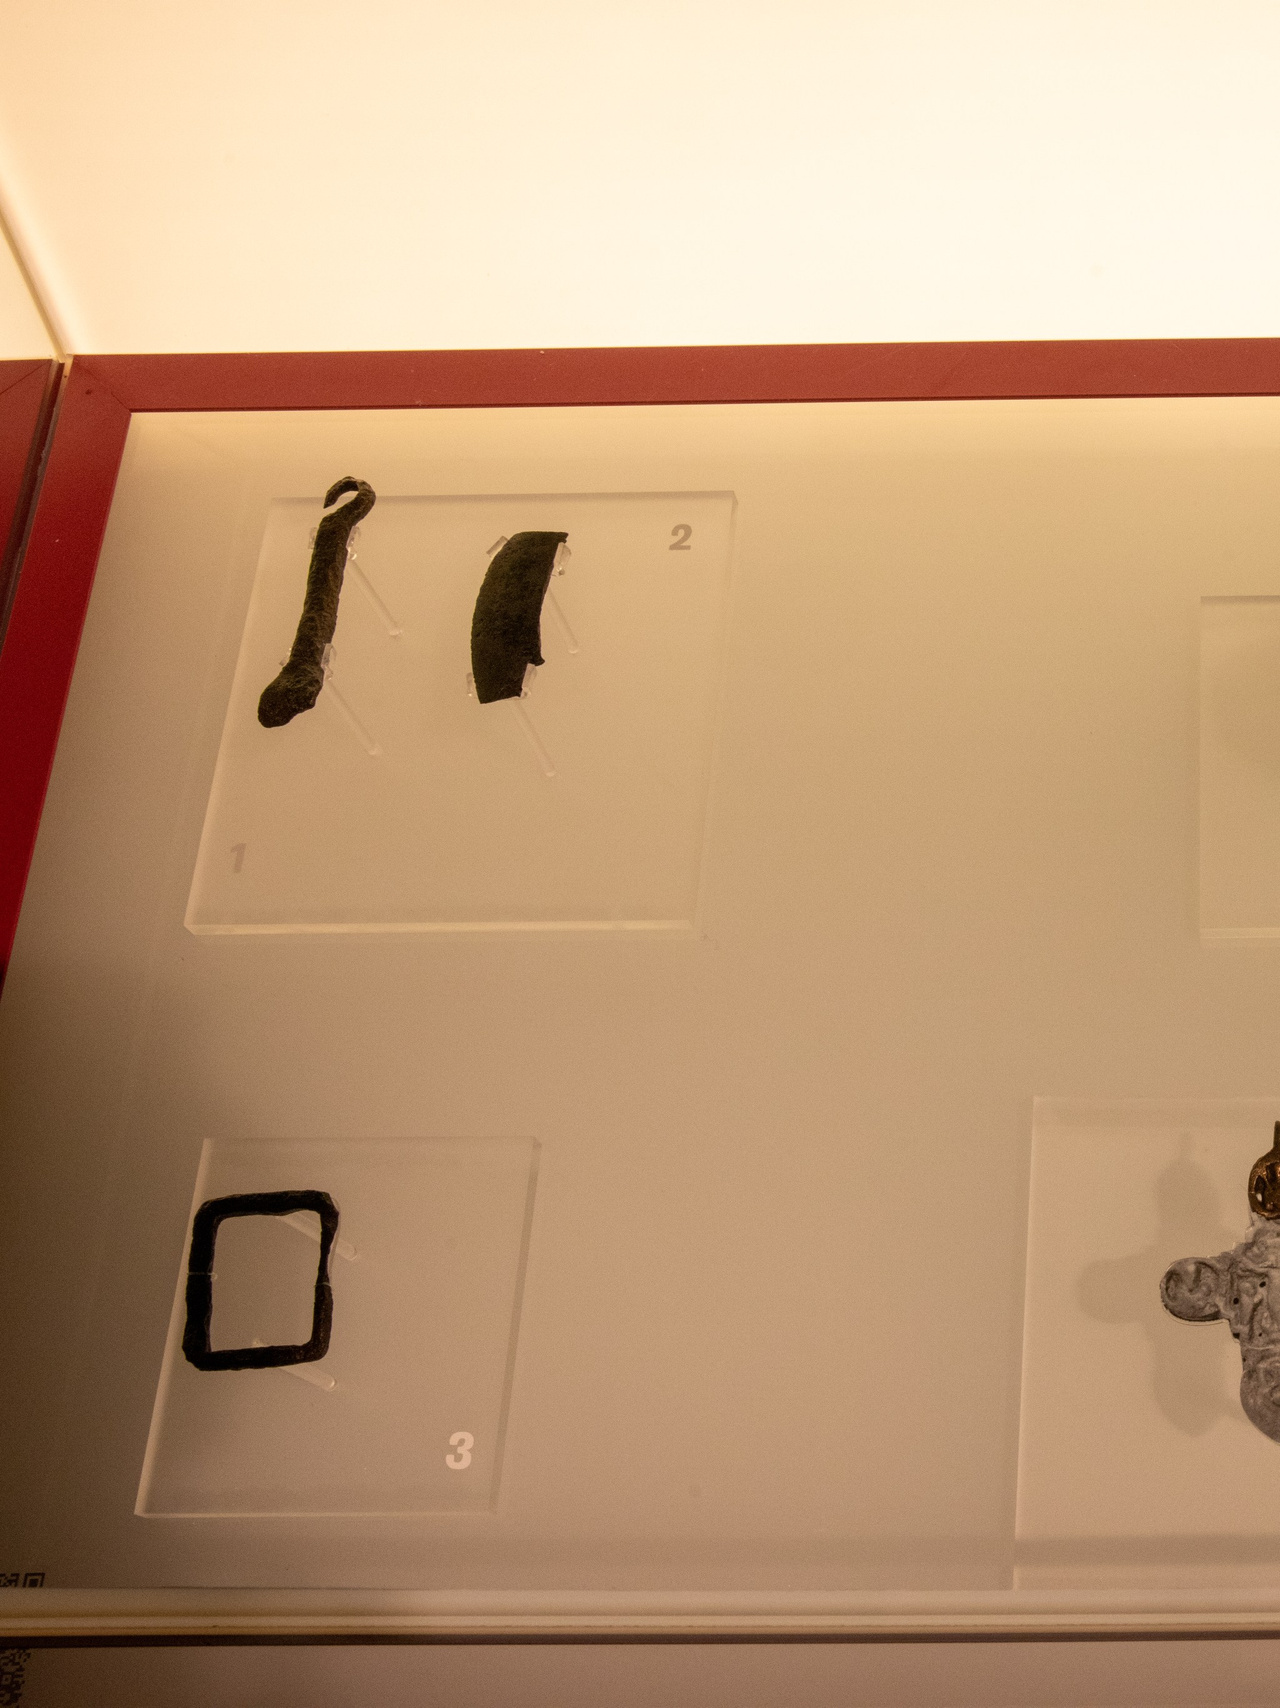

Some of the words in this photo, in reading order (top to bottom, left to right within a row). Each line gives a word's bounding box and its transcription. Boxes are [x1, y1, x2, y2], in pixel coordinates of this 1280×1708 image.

[668, 523, 693, 551] 2
[230, 842, 248, 874] 1
[445, 1431, 475, 1470] 3
